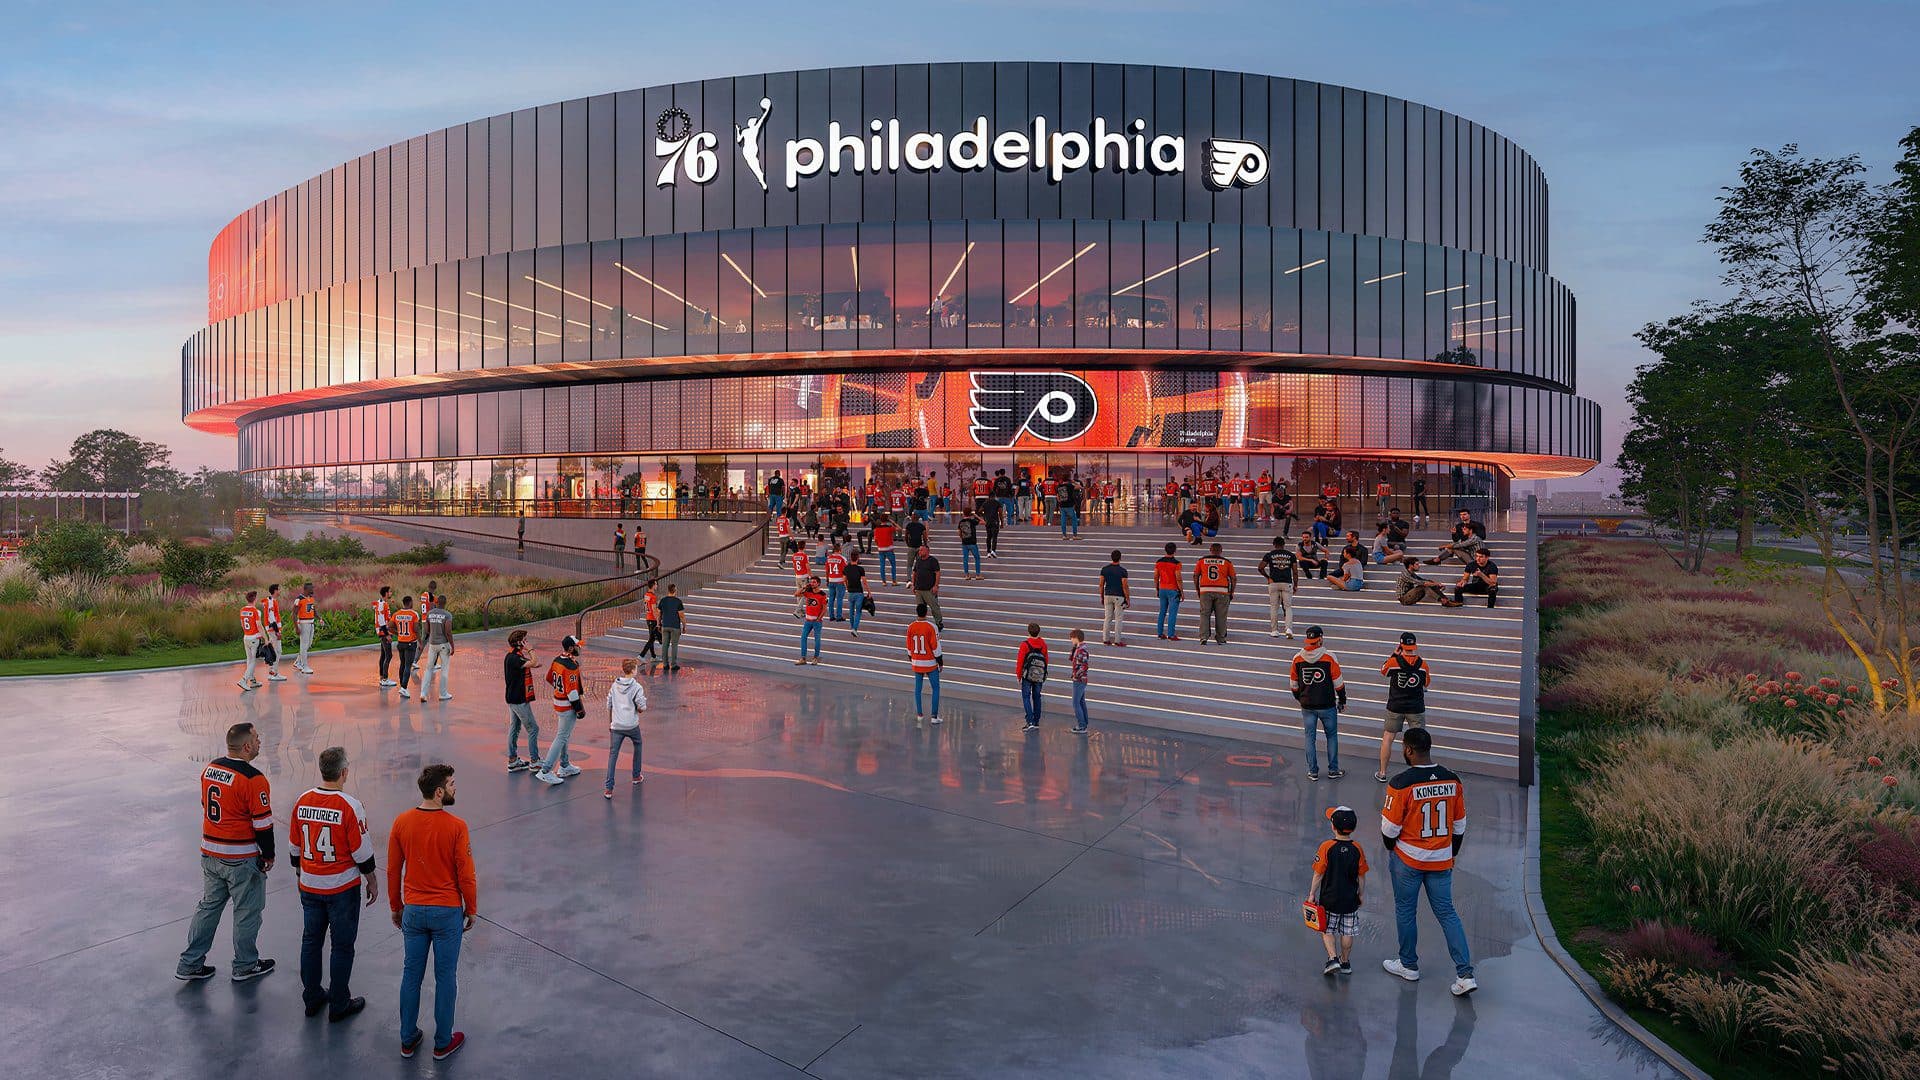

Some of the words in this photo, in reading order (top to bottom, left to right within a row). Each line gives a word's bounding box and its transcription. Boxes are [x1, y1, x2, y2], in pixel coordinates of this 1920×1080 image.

[655, 131, 718, 187] 76
[785, 116, 1185, 189] philadelphia
[796, 561, 801, 571] 6
[829, 563, 839, 574] 14
[1208, 565, 1219, 580] 6
[244, 618, 250, 630] 6
[399, 621, 410, 636] 11
[912, 635, 927, 655] 11
[206, 768, 233, 783] SANHEIM
[1416, 784, 1454, 798] KONECNY
[207, 784, 221, 823] 6
[260, 792, 269, 806] 6
[1384, 795, 1393, 810] 11
[298, 807, 340, 822] COUTURIER
[1420, 800, 1448, 838] 11
[301, 823, 337, 862] 14
